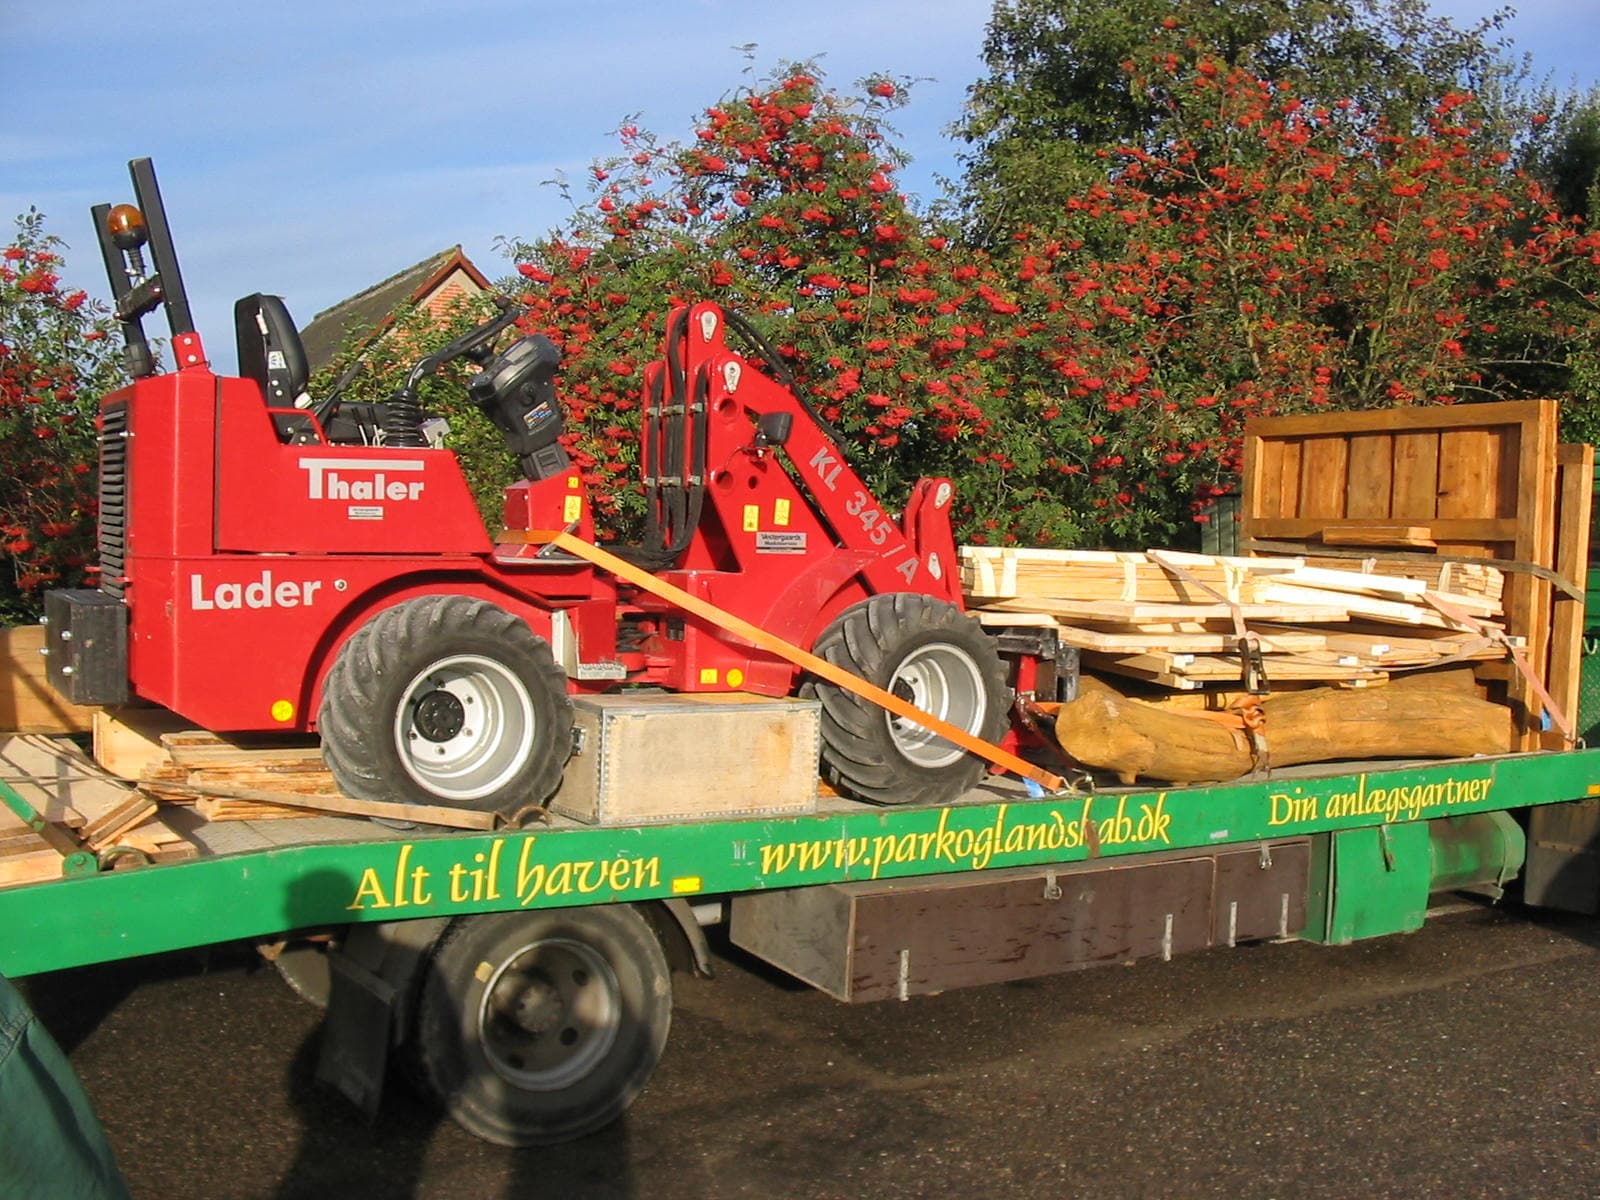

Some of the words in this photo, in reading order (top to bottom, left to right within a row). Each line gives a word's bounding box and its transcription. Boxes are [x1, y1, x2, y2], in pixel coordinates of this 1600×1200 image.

[299, 458, 424, 500] Thaler
[810, 447, 842, 492] KL
[846, 491, 892, 545] 345
[191, 570, 321, 610] Lader
[1268, 787, 1317, 825] Din
[1325, 773, 1492, 821] anlægsgartner
[346, 844, 432, 910] Alt
[448, 839, 504, 902] til
[516, 836, 661, 906] haven
